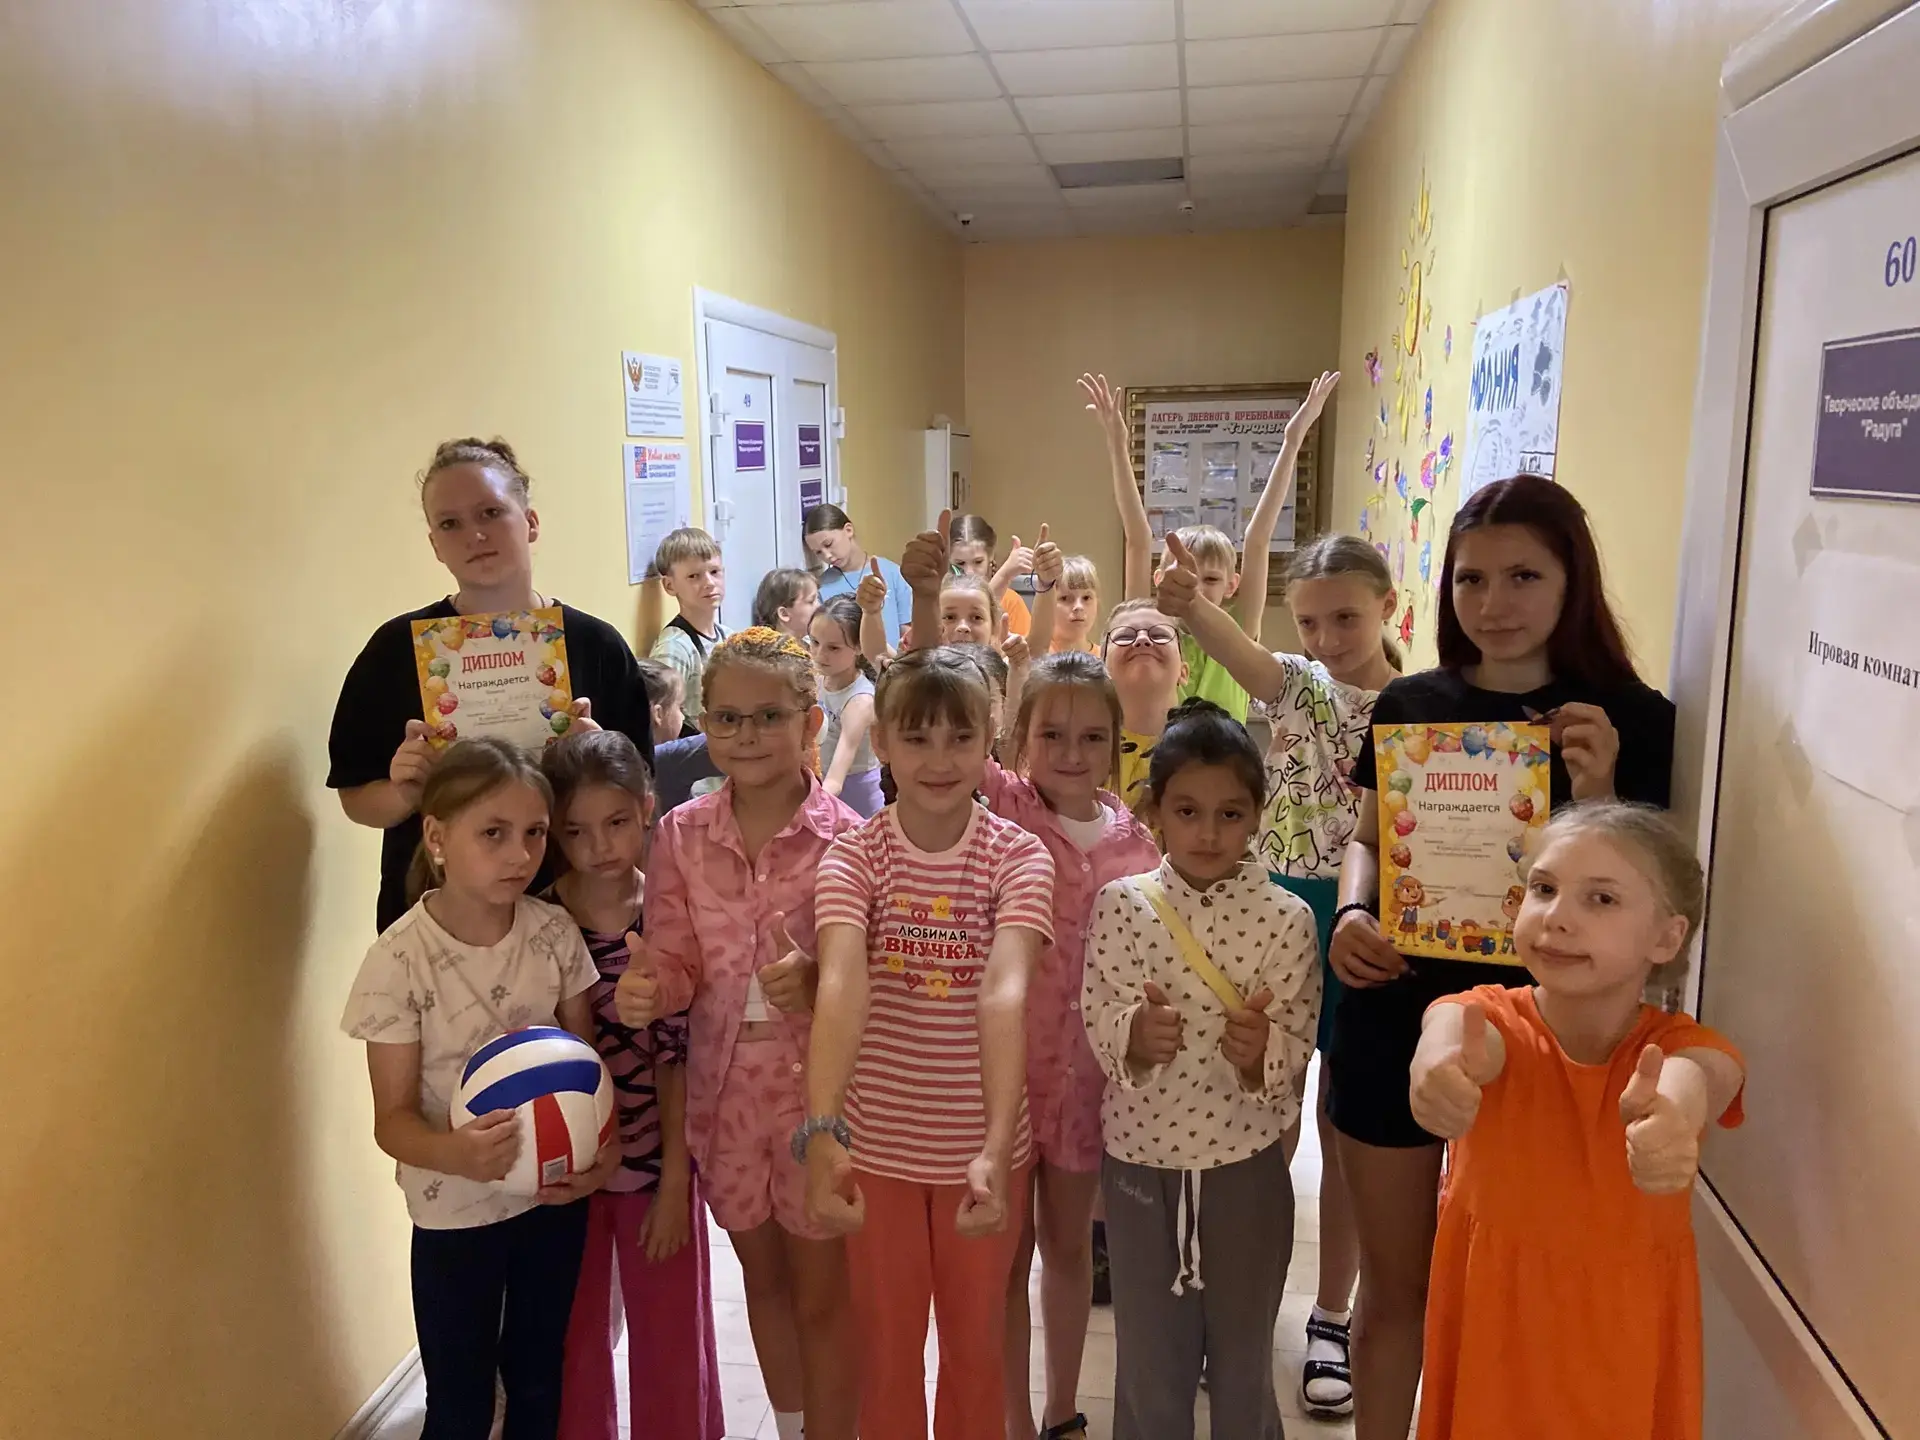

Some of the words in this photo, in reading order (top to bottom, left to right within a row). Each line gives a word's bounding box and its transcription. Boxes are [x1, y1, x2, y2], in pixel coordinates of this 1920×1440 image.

[1884, 235, 1917, 288] 60
[1469, 343, 1520, 415] МОЛНИЯ
[1824, 394, 1880, 417] Творческое
[1151, 412, 1184, 423] ЛАГЕРЬ
[1187, 411, 1230, 422] ДНЕВНОГО
[1861, 417, 1909, 443] "Радуга"
[1808, 630, 1860, 666] Игровая
[462, 651, 525, 673] ДИПЛОМ
[458, 675, 530, 690] Награждается
[1424, 772, 1499, 793] ДИПЛОМ
[1418, 801, 1501, 817] Награждается
[897, 924, 969, 941] ЛЮБИМАЯ
[884, 935, 979, 960] ВНУЧКА
